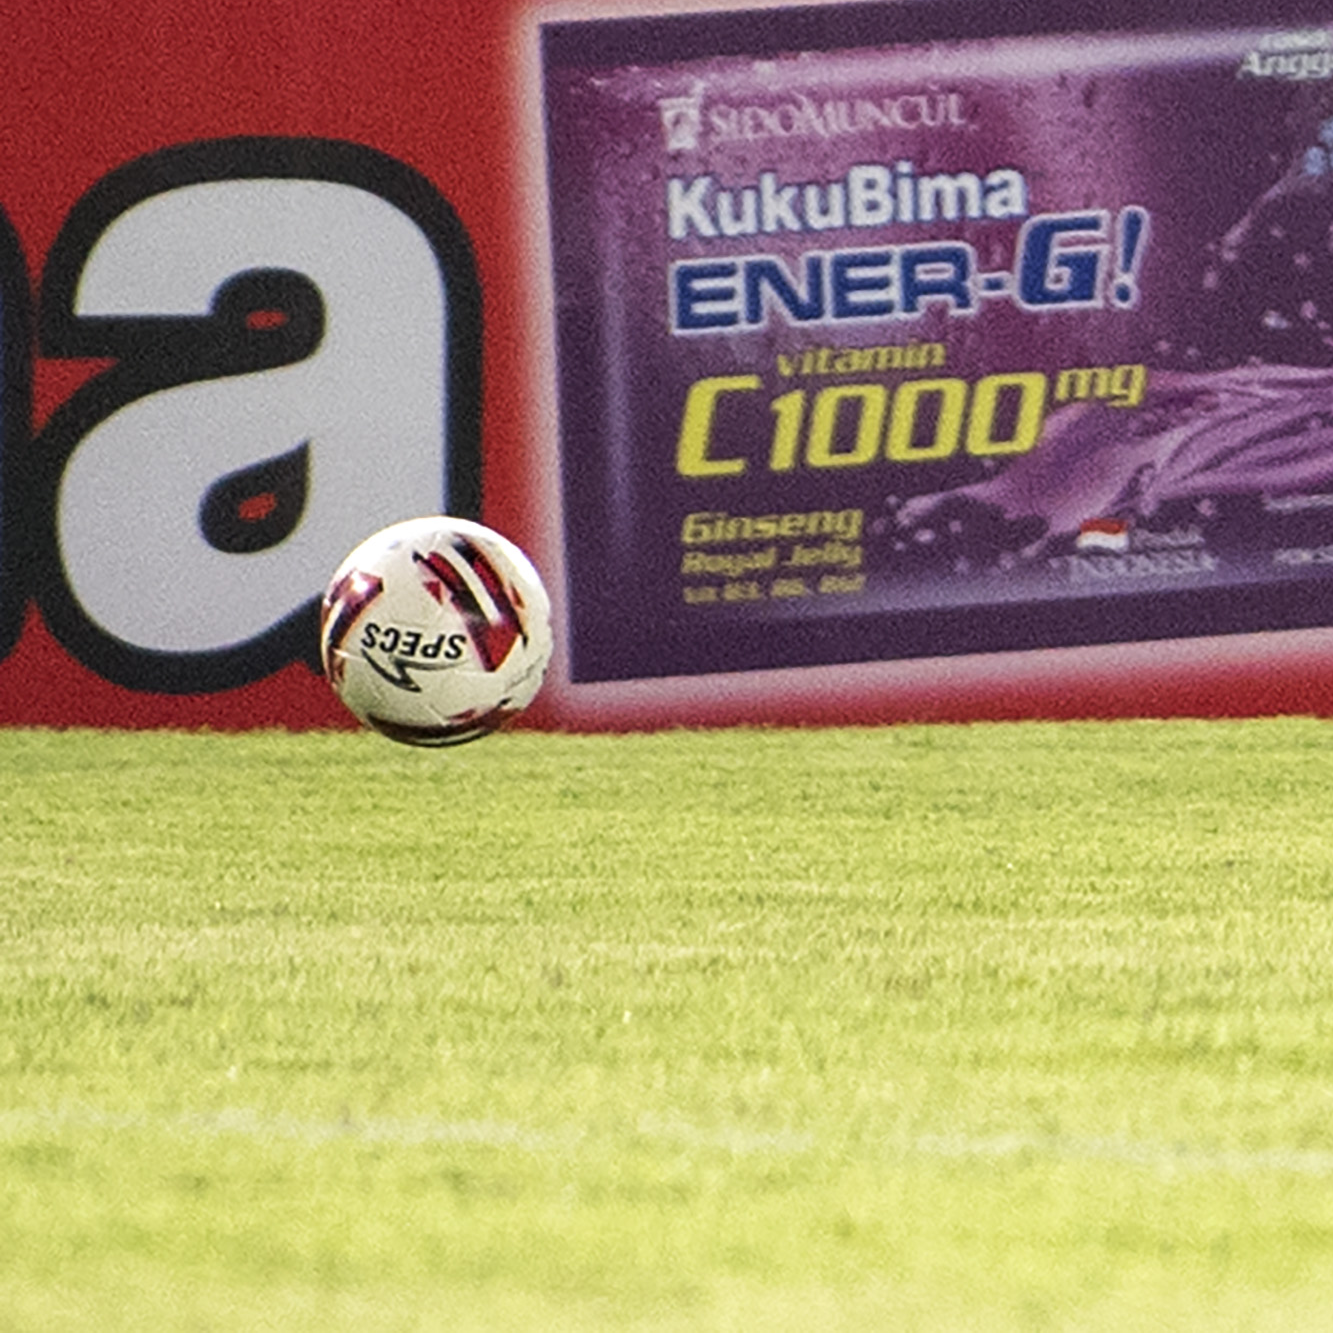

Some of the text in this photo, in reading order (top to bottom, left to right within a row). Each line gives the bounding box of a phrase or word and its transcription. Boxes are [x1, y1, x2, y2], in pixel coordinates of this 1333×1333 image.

[665, 158, 1026, 239] KukuBima
[670, 206, 1150, 336] ENER-G!
[776, 342, 946, 376] vitamin
[0, 136, 482, 694] a
[680, 508, 865, 544] Ginseng
[360, 621, 467, 660] SPECS
